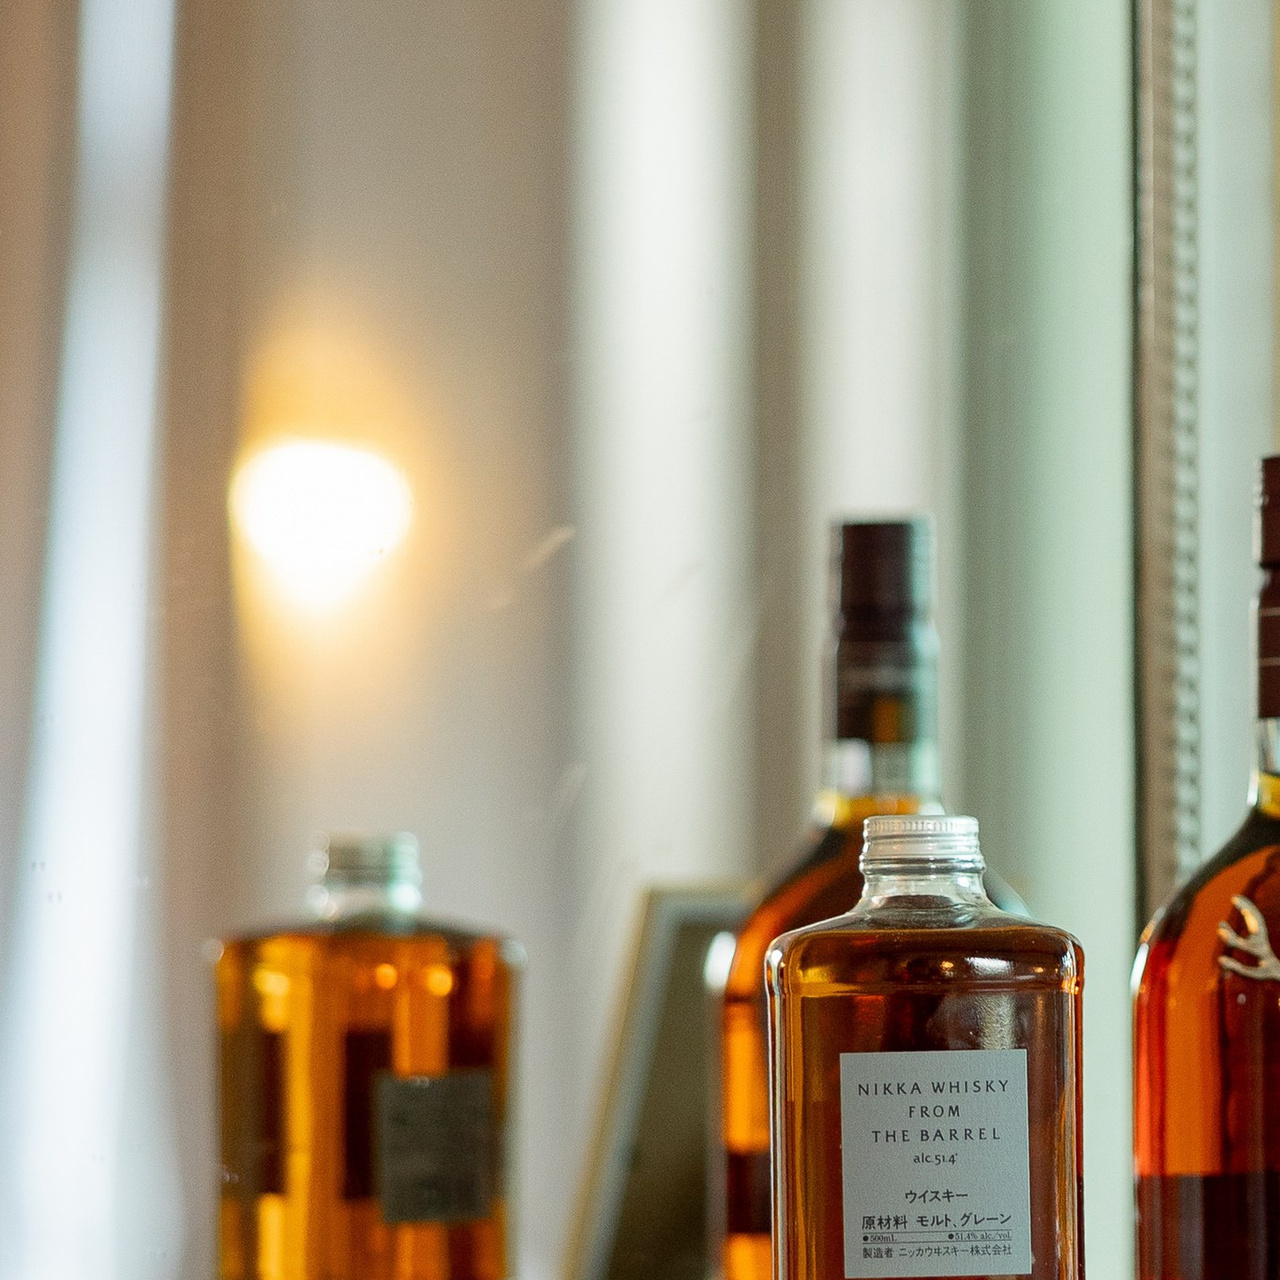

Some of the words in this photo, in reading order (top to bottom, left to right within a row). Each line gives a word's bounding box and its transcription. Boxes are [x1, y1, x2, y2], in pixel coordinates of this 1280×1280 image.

[858, 1082, 923, 1097] NIKKA
[930, 1079, 1010, 1095] WHISKY
[908, 1104, 961, 1119] FROM
[871, 1129, 911, 1143] THE
[919, 1127, 1002, 1142] BARREL
[904, 1188, 969, 1204] ウイスキー
[861, 1214, 908, 1230] 原材料
